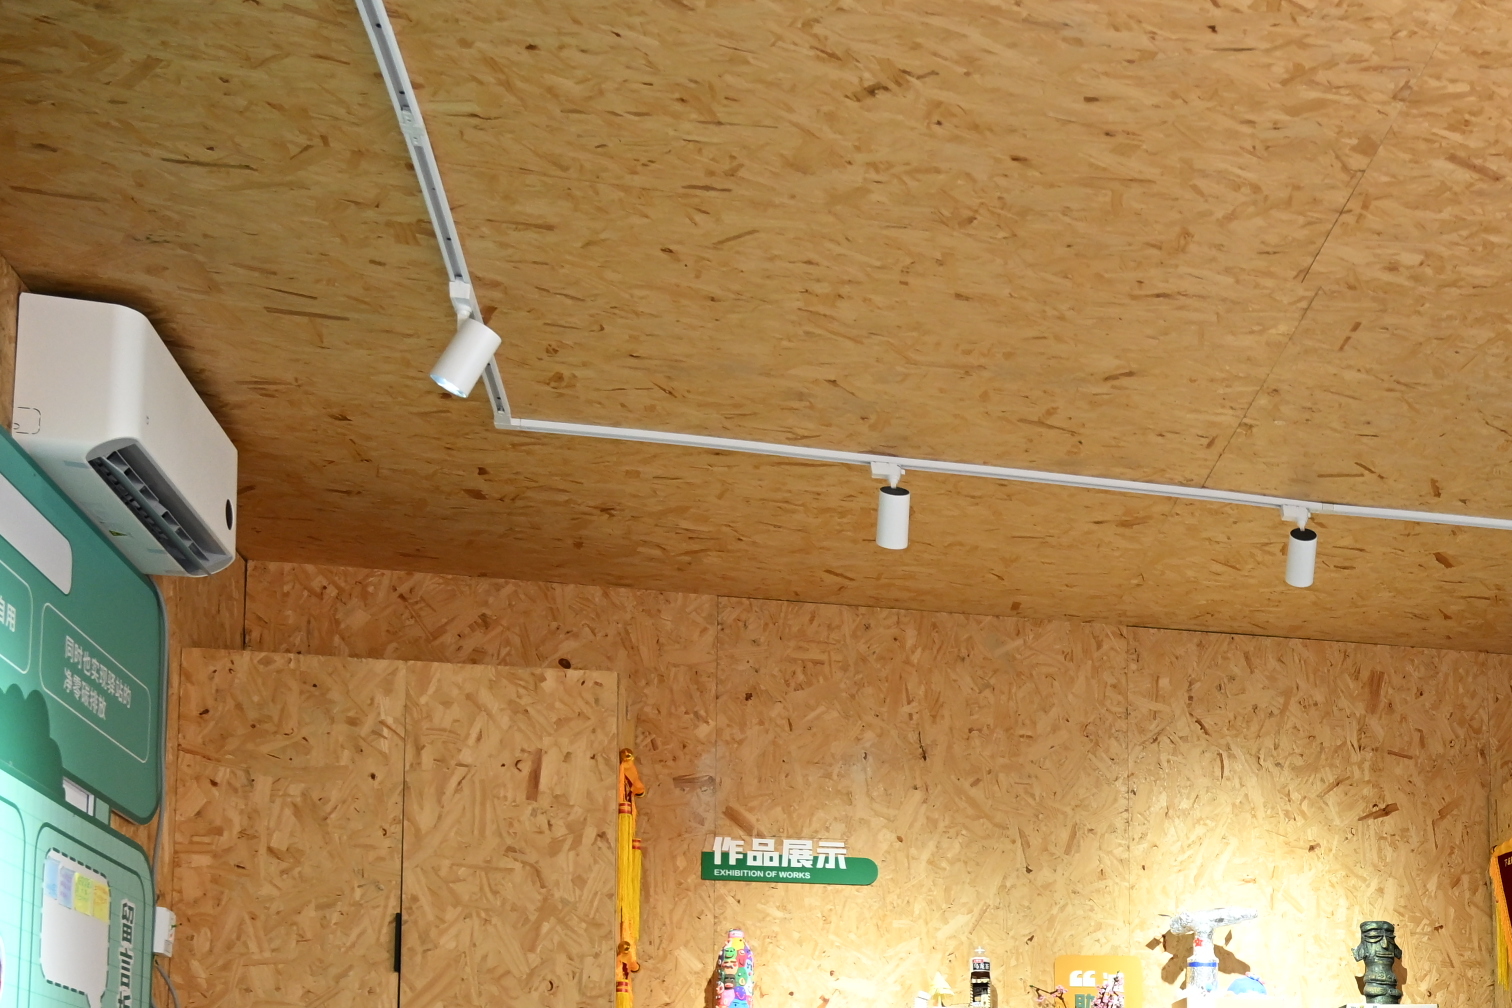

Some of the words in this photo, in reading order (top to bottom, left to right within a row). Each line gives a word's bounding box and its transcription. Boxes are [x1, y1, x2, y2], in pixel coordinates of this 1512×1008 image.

[64, 635, 132, 708] 同时也实现驿站的
[64, 667, 106, 720] 净零碳排放
[713, 837, 847, 869] 作品展示
[714, 869, 764, 877] EXHIBITION
